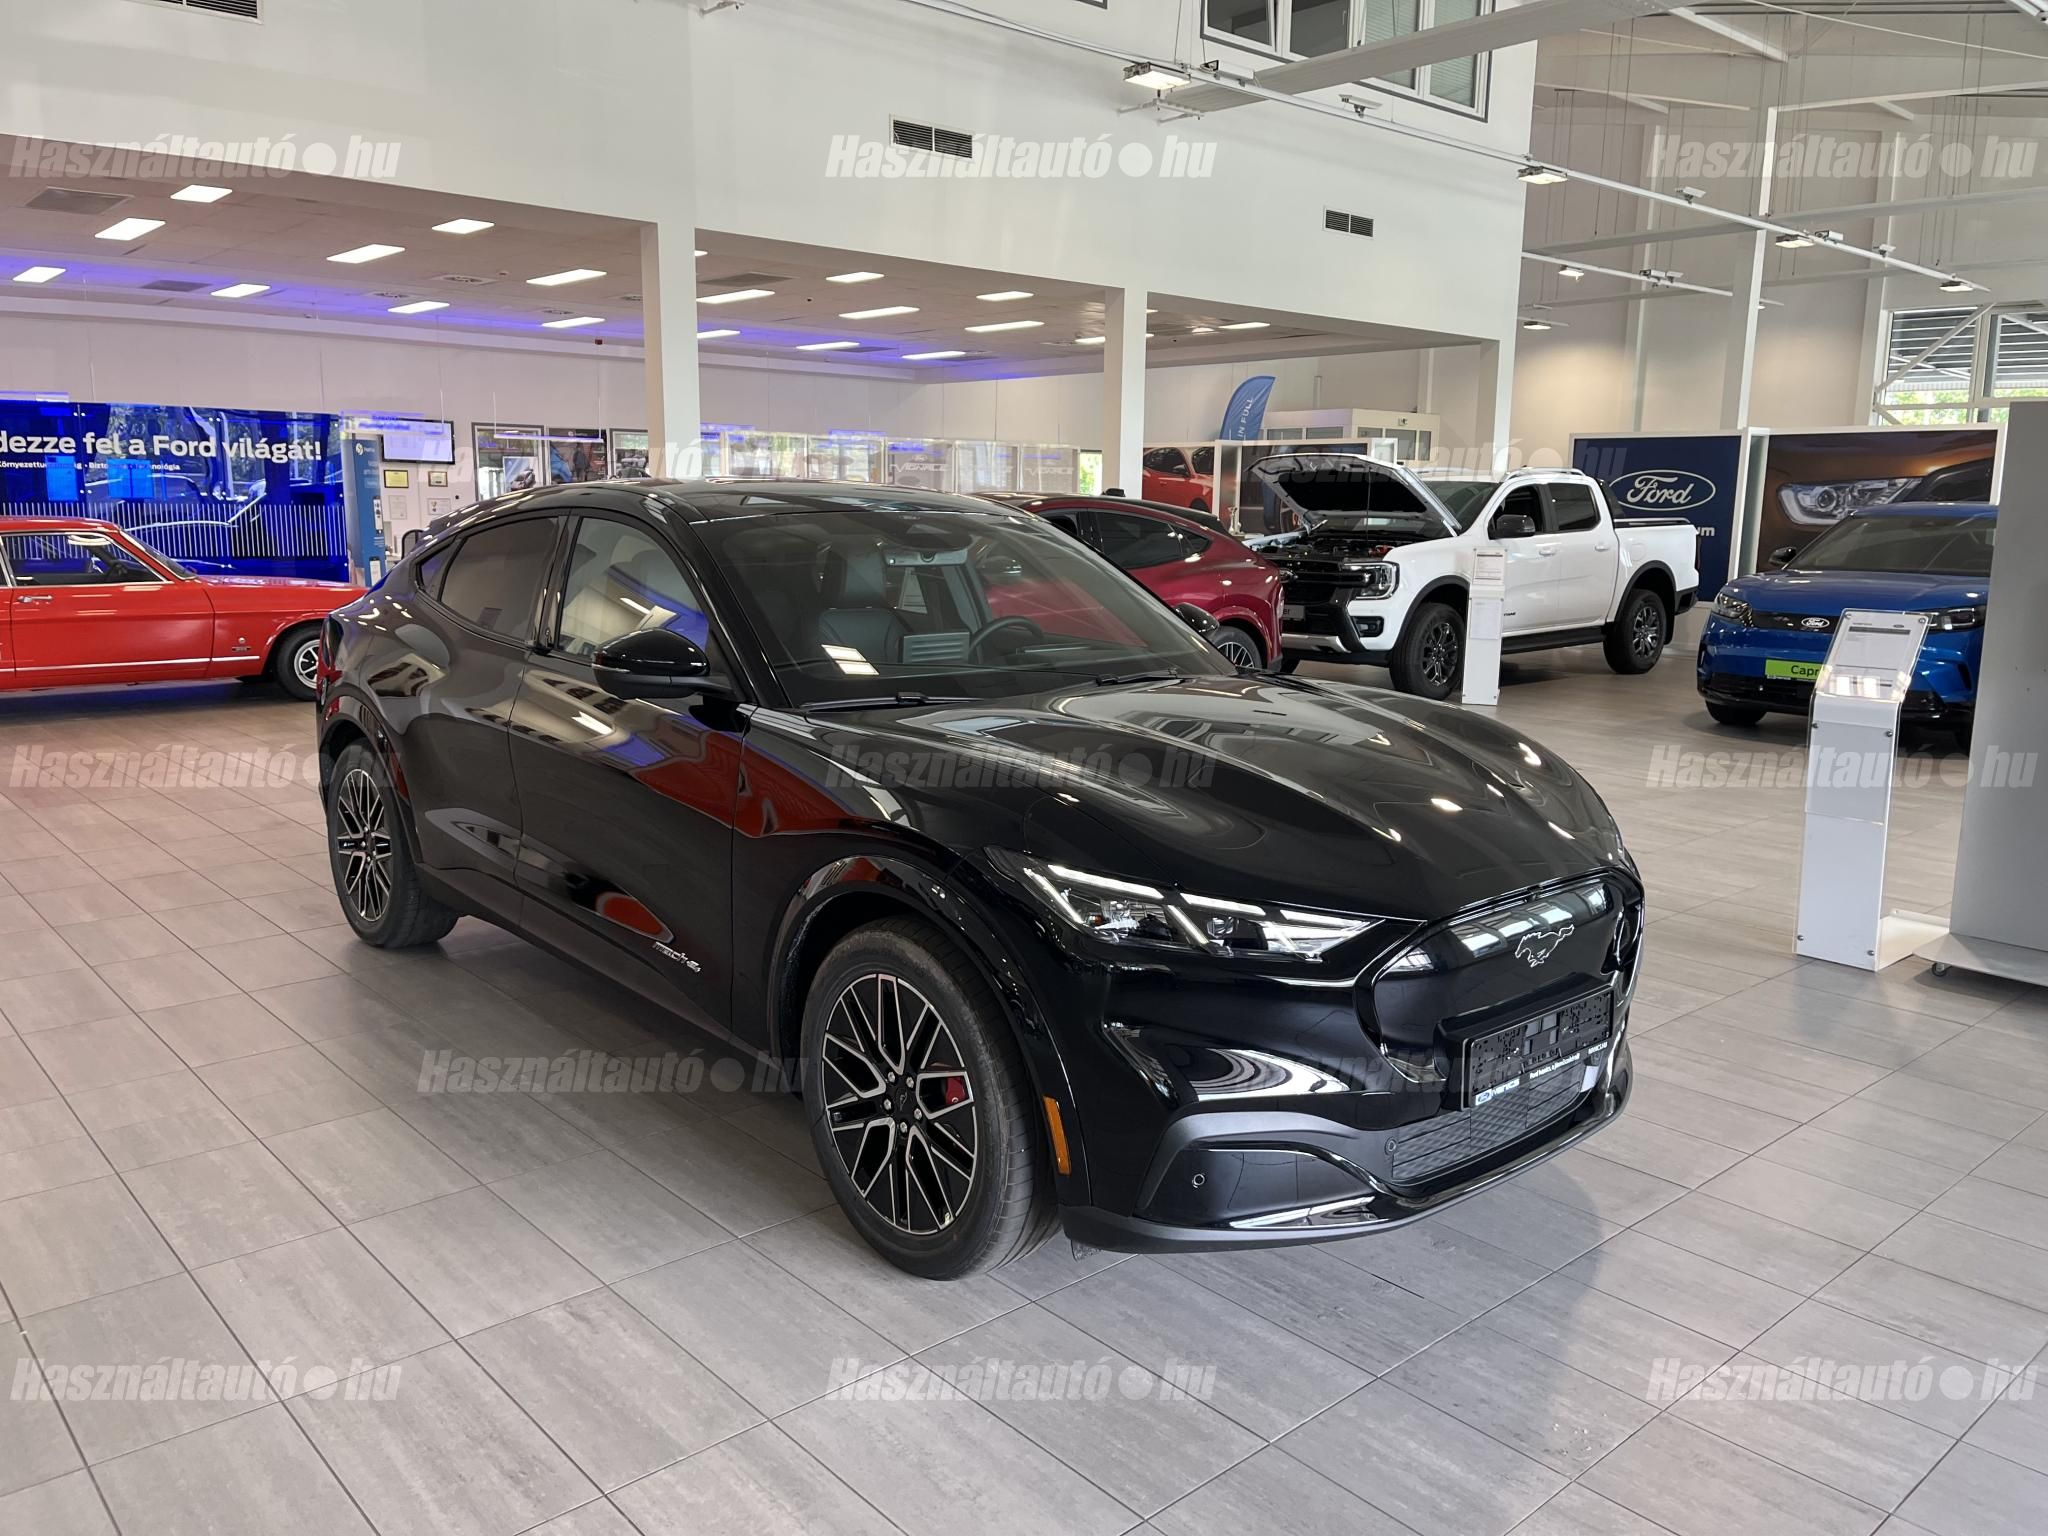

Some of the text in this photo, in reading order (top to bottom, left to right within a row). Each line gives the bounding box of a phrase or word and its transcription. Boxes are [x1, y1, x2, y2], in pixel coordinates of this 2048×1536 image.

[83, 432, 122, 455] fel
[129, 438, 147, 455] a
[153, 435, 216, 457] Ford
[222, 437, 321, 463] világát!
[1627, 475, 1695, 504] Ford
[1791, 664, 1820, 677] Capr
